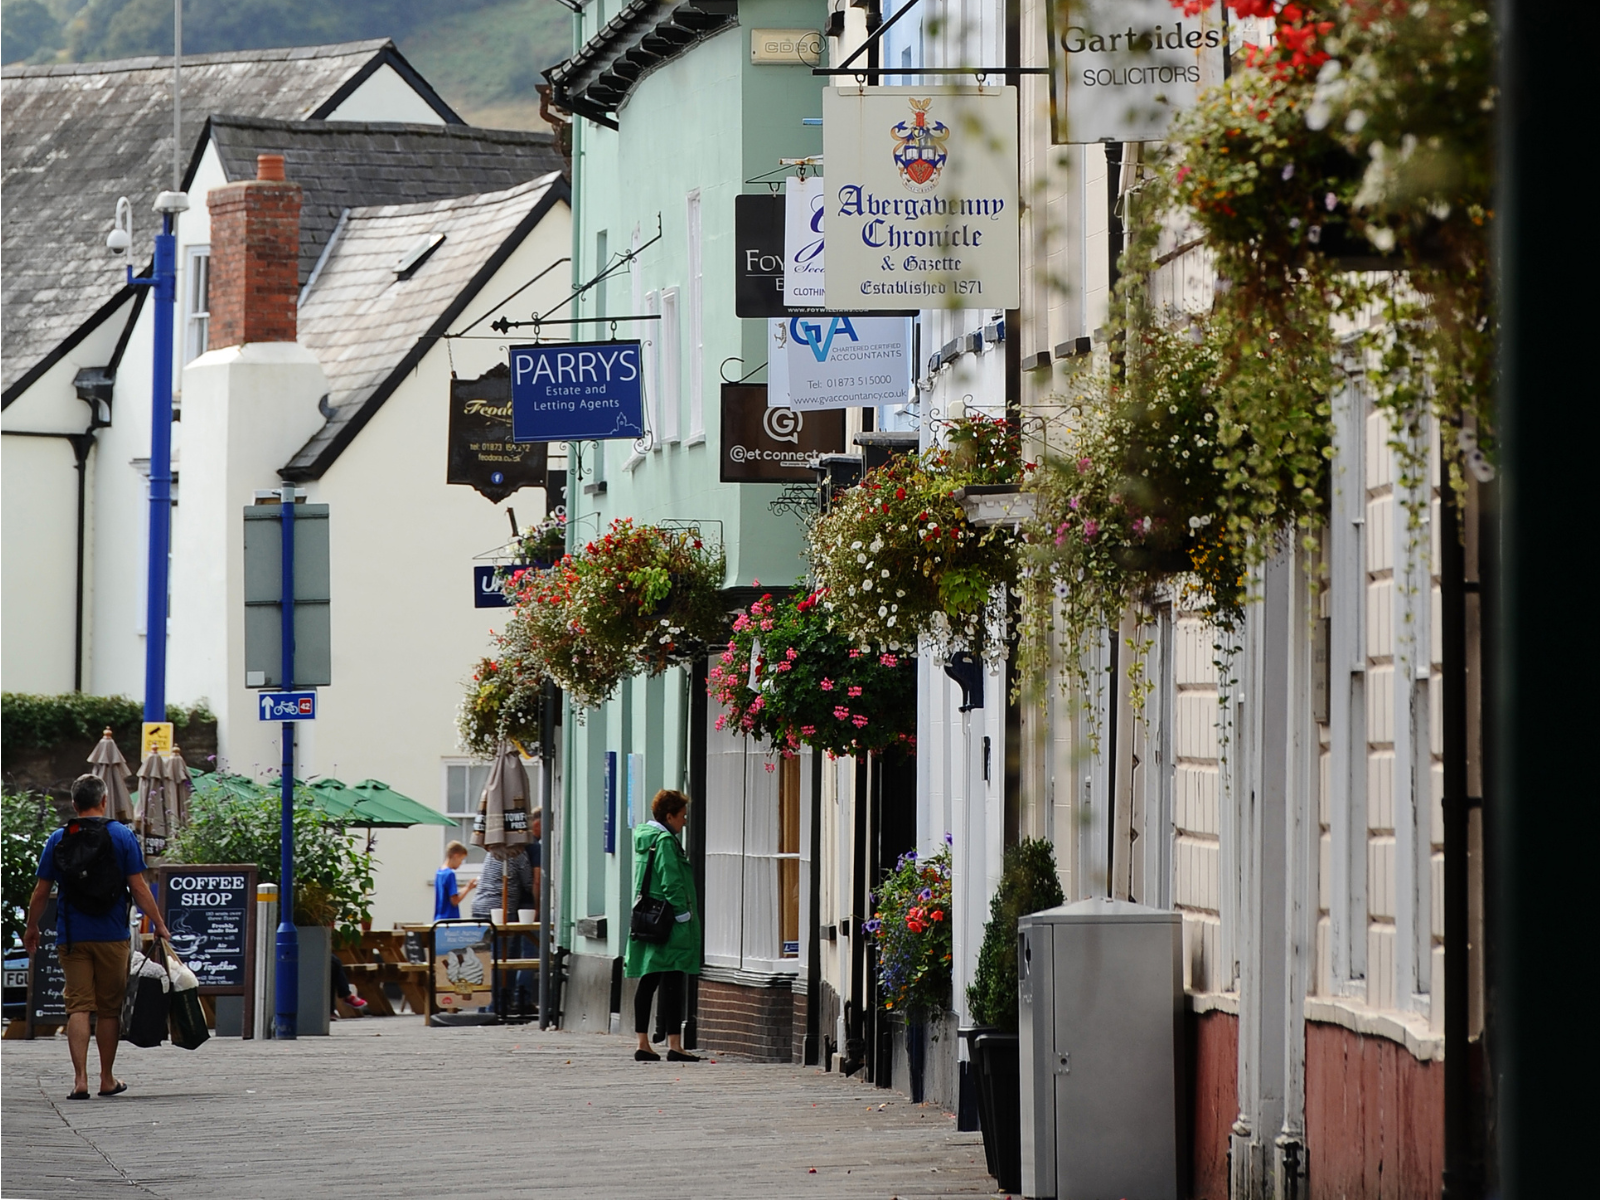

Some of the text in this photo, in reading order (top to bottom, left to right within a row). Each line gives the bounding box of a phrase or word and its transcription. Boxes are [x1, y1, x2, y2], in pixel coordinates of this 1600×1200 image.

[765, 41, 808, 54] CDS
[1083, 65, 1200, 87] SOLICITORS
[838, 184, 1004, 221] Abergavenny
[862, 218, 982, 251] Chronicle
[881, 255, 962, 274] & Gazette
[860, 280, 982, 297] Established 1871
[832, 342, 901, 353] CHARTERED CERTIFIED
[829, 349, 902, 363] ACCOUNTANTS
[515, 350, 637, 386] PARRYS
[806, 374, 892, 390] Tel: 01873 515000
[546, 383, 607, 397] Estate and
[794, 388, 908, 406] www.gvaccountancy.co.uk
[533, 398, 620, 412] Letting Agents
[481, 443, 502, 451] 01873
[300, 702, 311, 710] 42
[169, 876, 245, 891] COFFEE
[181, 892, 233, 906] SHOP
